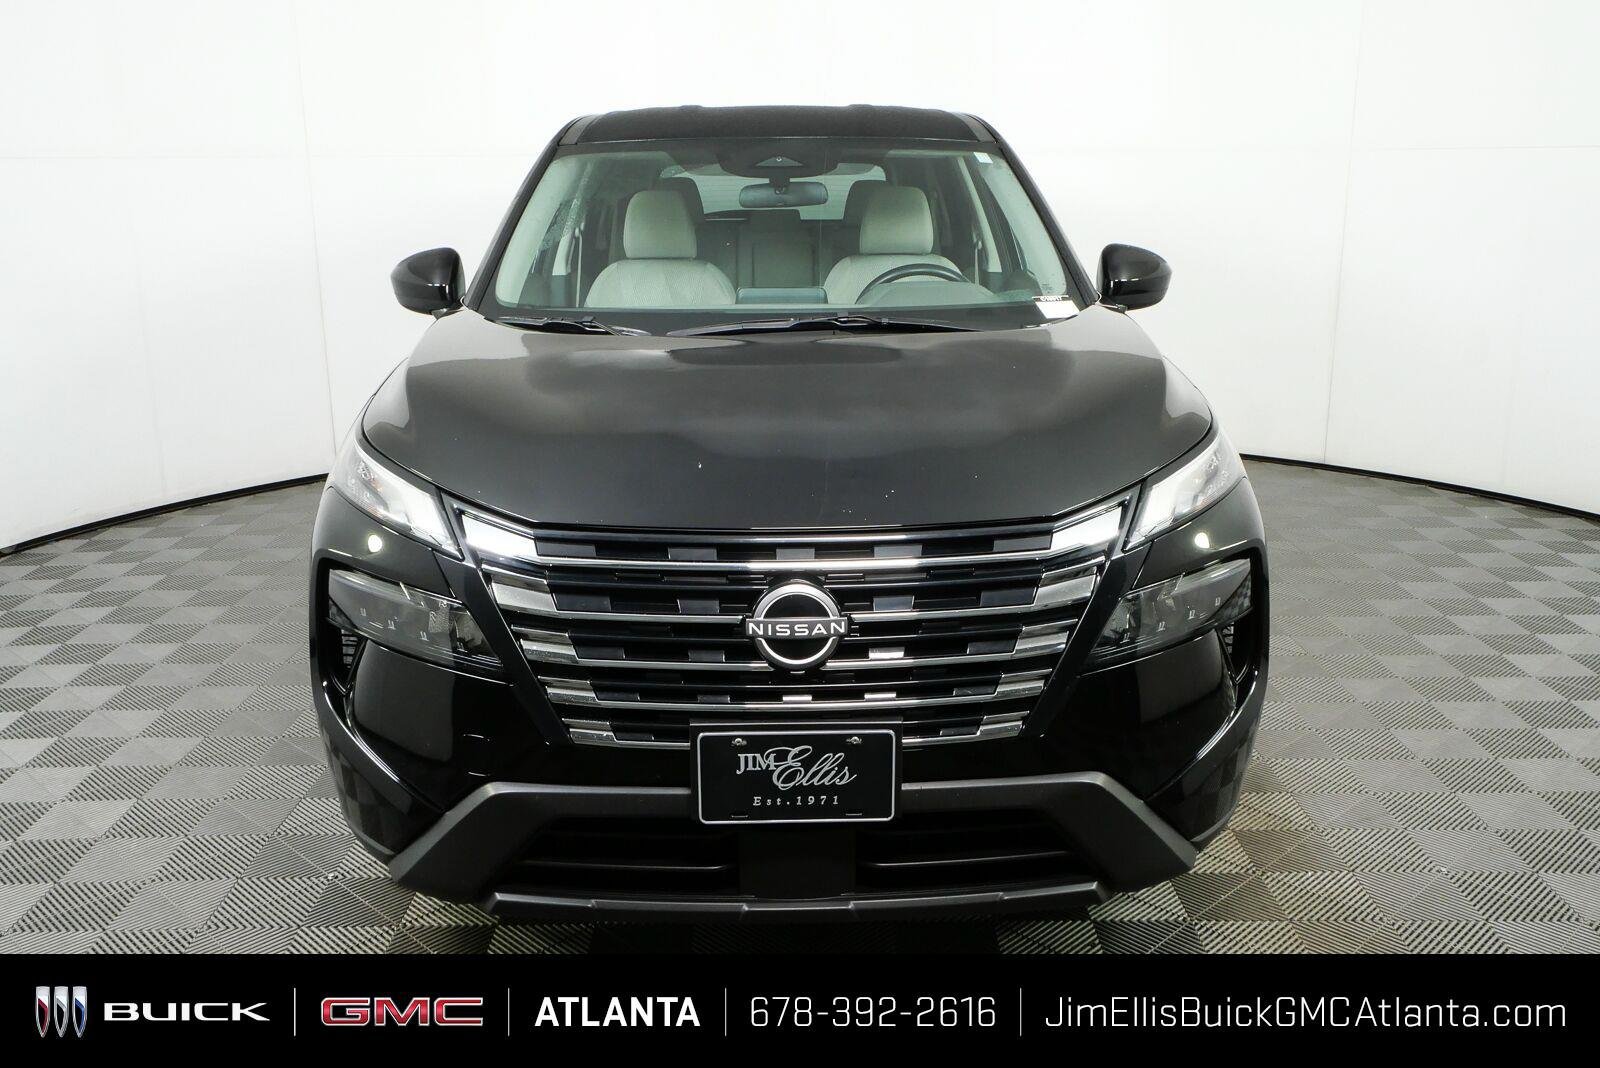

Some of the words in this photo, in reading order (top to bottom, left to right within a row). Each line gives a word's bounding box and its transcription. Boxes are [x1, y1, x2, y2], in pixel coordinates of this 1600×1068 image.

[748, 621, 846, 637] NISSAN
[736, 753, 777, 775] JIM
[763, 745, 858, 791] Ellis
